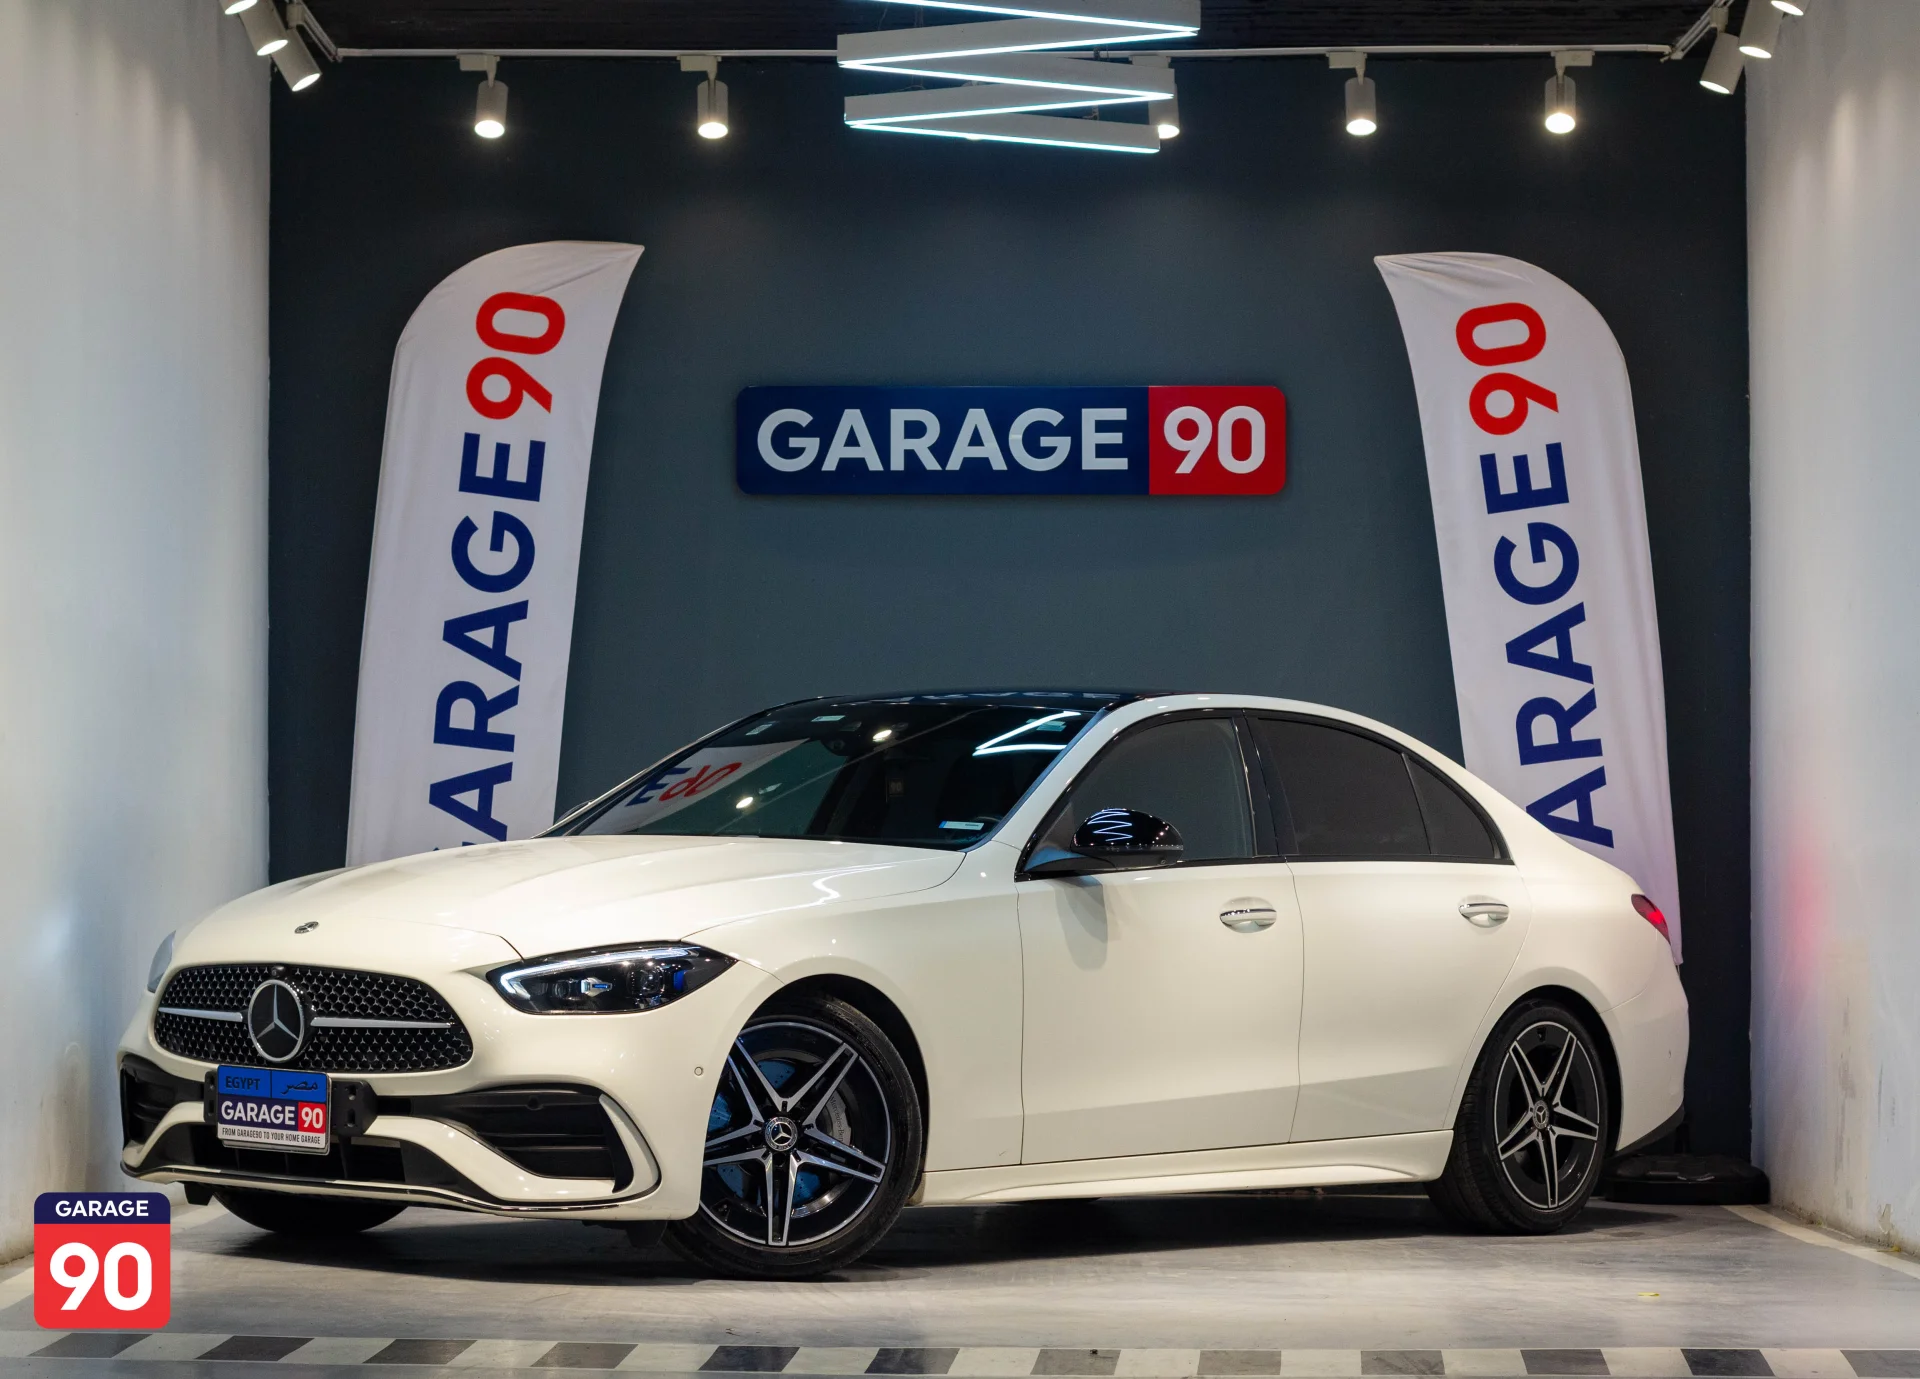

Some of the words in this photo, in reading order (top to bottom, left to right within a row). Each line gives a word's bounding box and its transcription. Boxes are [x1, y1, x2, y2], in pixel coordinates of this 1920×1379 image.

[757, 407, 1129, 472] GARAGE
[1163, 405, 1266, 474] 90
[429, 292, 566, 851] ARAGE90
[225, 1076, 260, 1090] EGYPT
[281, 1081, 318, 1095] مصر
[221, 1101, 296, 1126] GARAGE
[301, 1107, 323, 1128] 90
[830, 1096, 845, 1142] Mercedes-Ben
[222, 1127, 236, 1136] FROM
[237, 1129, 262, 1139] GARAGE90
[263, 1131, 270, 1139] TO
[271, 1133, 285, 1141] YOUR
[285, 1134, 300, 1142] HOME
[301, 1135, 321, 1144] GARAGE
